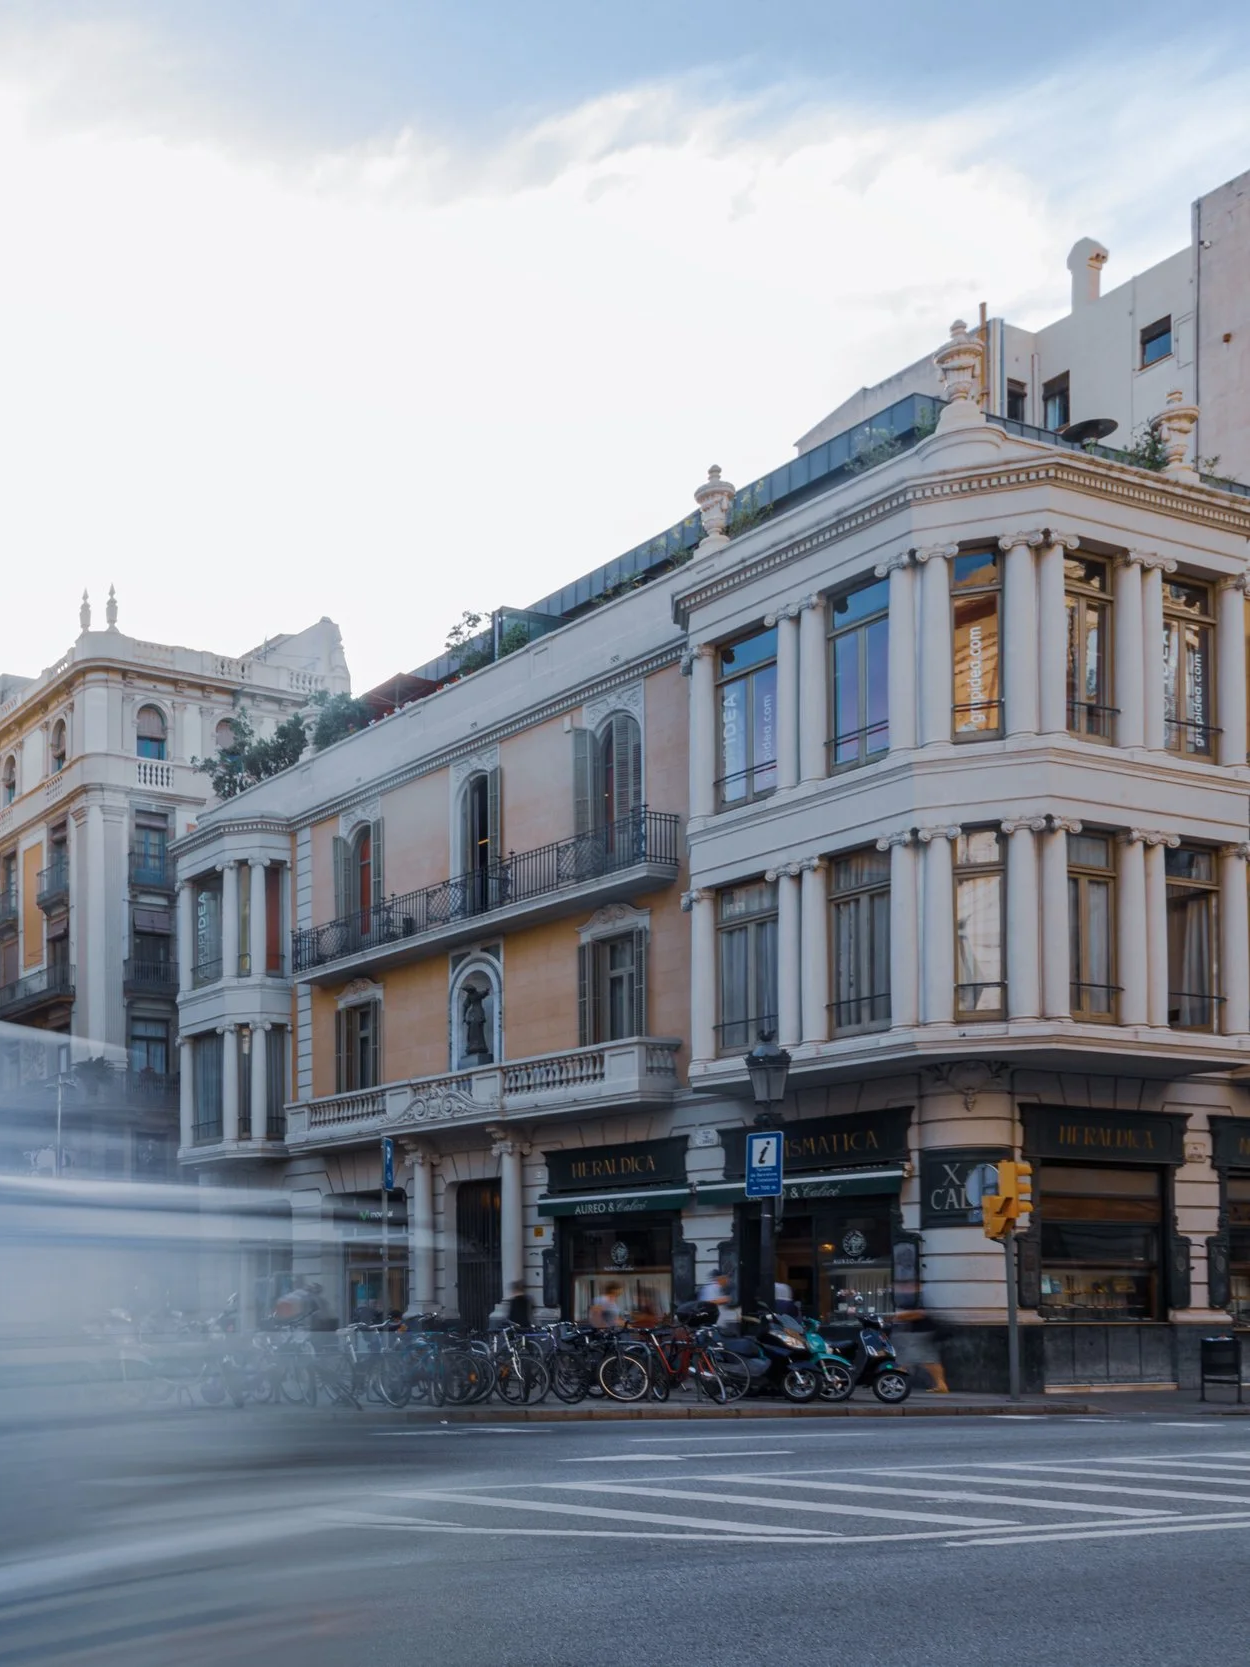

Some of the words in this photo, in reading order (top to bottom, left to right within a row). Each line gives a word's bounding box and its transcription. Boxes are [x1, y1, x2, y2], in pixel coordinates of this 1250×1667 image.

[761, 694, 774, 782] gpidea.com
[784, 1130, 879, 1158] ISMATICA
[571, 1155, 656, 1179] HERALDICA
[790, 1187, 799, 1199] &
[574, 1202, 606, 1216] AUREO
[608, 1201, 616, 1213] &
